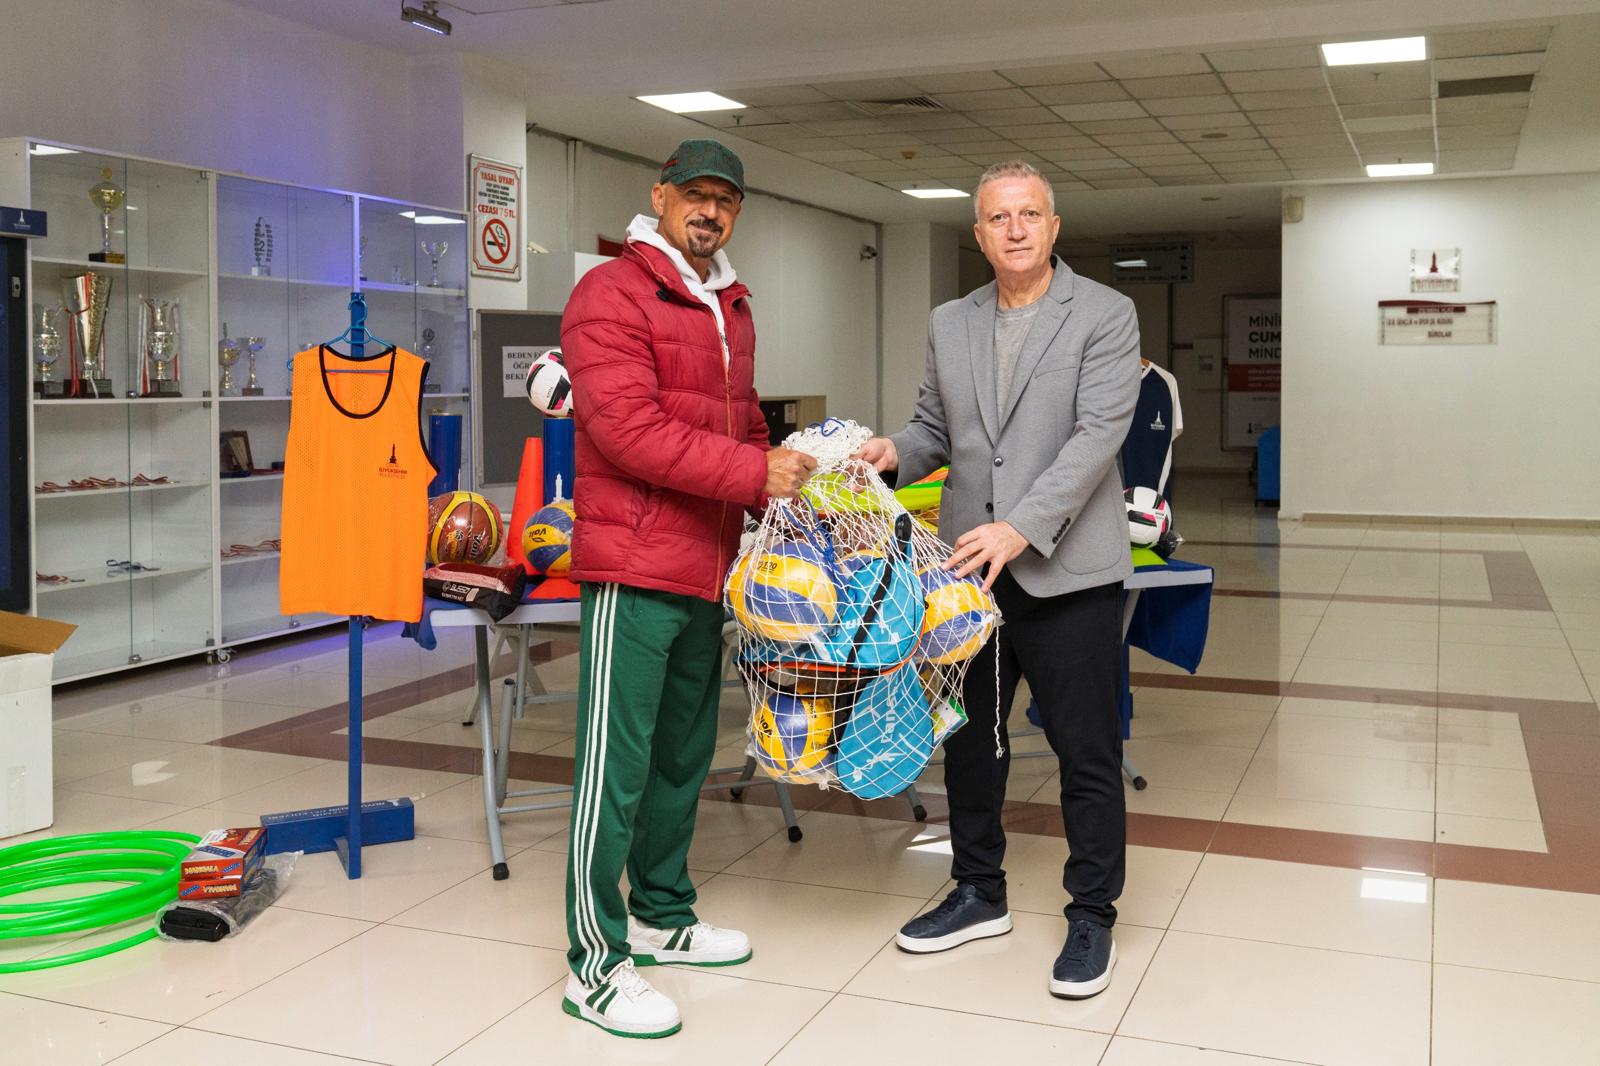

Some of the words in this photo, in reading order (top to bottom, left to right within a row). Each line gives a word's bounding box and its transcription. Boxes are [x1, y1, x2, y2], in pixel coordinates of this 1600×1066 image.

[480, 171, 497, 182] YASAL
[498, 175, 515, 186] UYARI
[478, 204, 499, 214] CEZASI
[513, 362, 532, 370] ÖĞR
[529, 527, 547, 538] Voit
